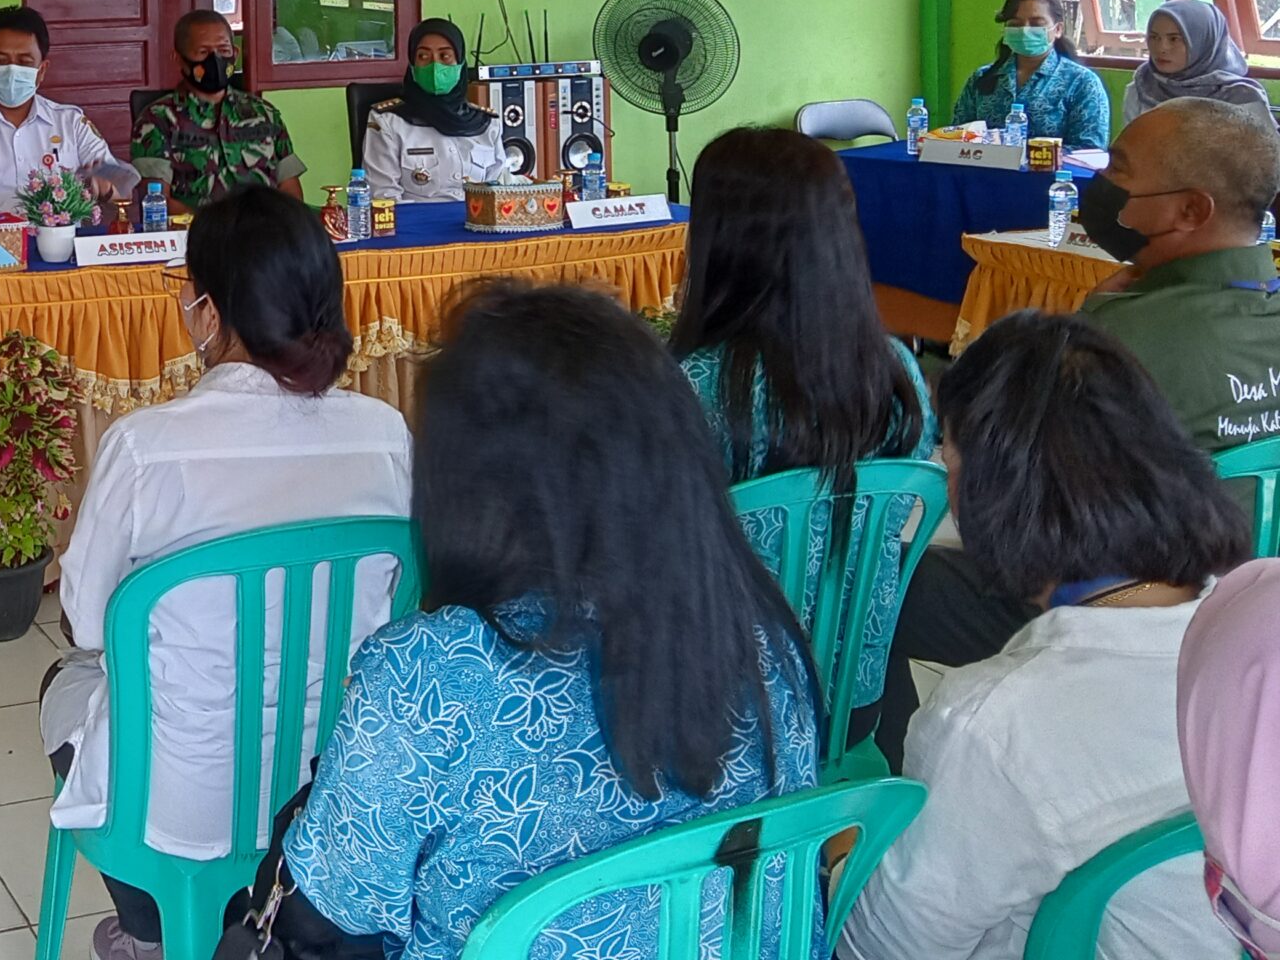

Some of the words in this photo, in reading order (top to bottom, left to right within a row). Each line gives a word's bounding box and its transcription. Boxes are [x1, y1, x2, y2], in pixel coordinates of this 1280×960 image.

[1030, 147, 1052, 159] teh
[374, 207, 394, 222] teh
[591, 202, 646, 219] CAMAT
[97, 240, 167, 256] ASISTEN
[1225, 373, 1268, 404] Desa
